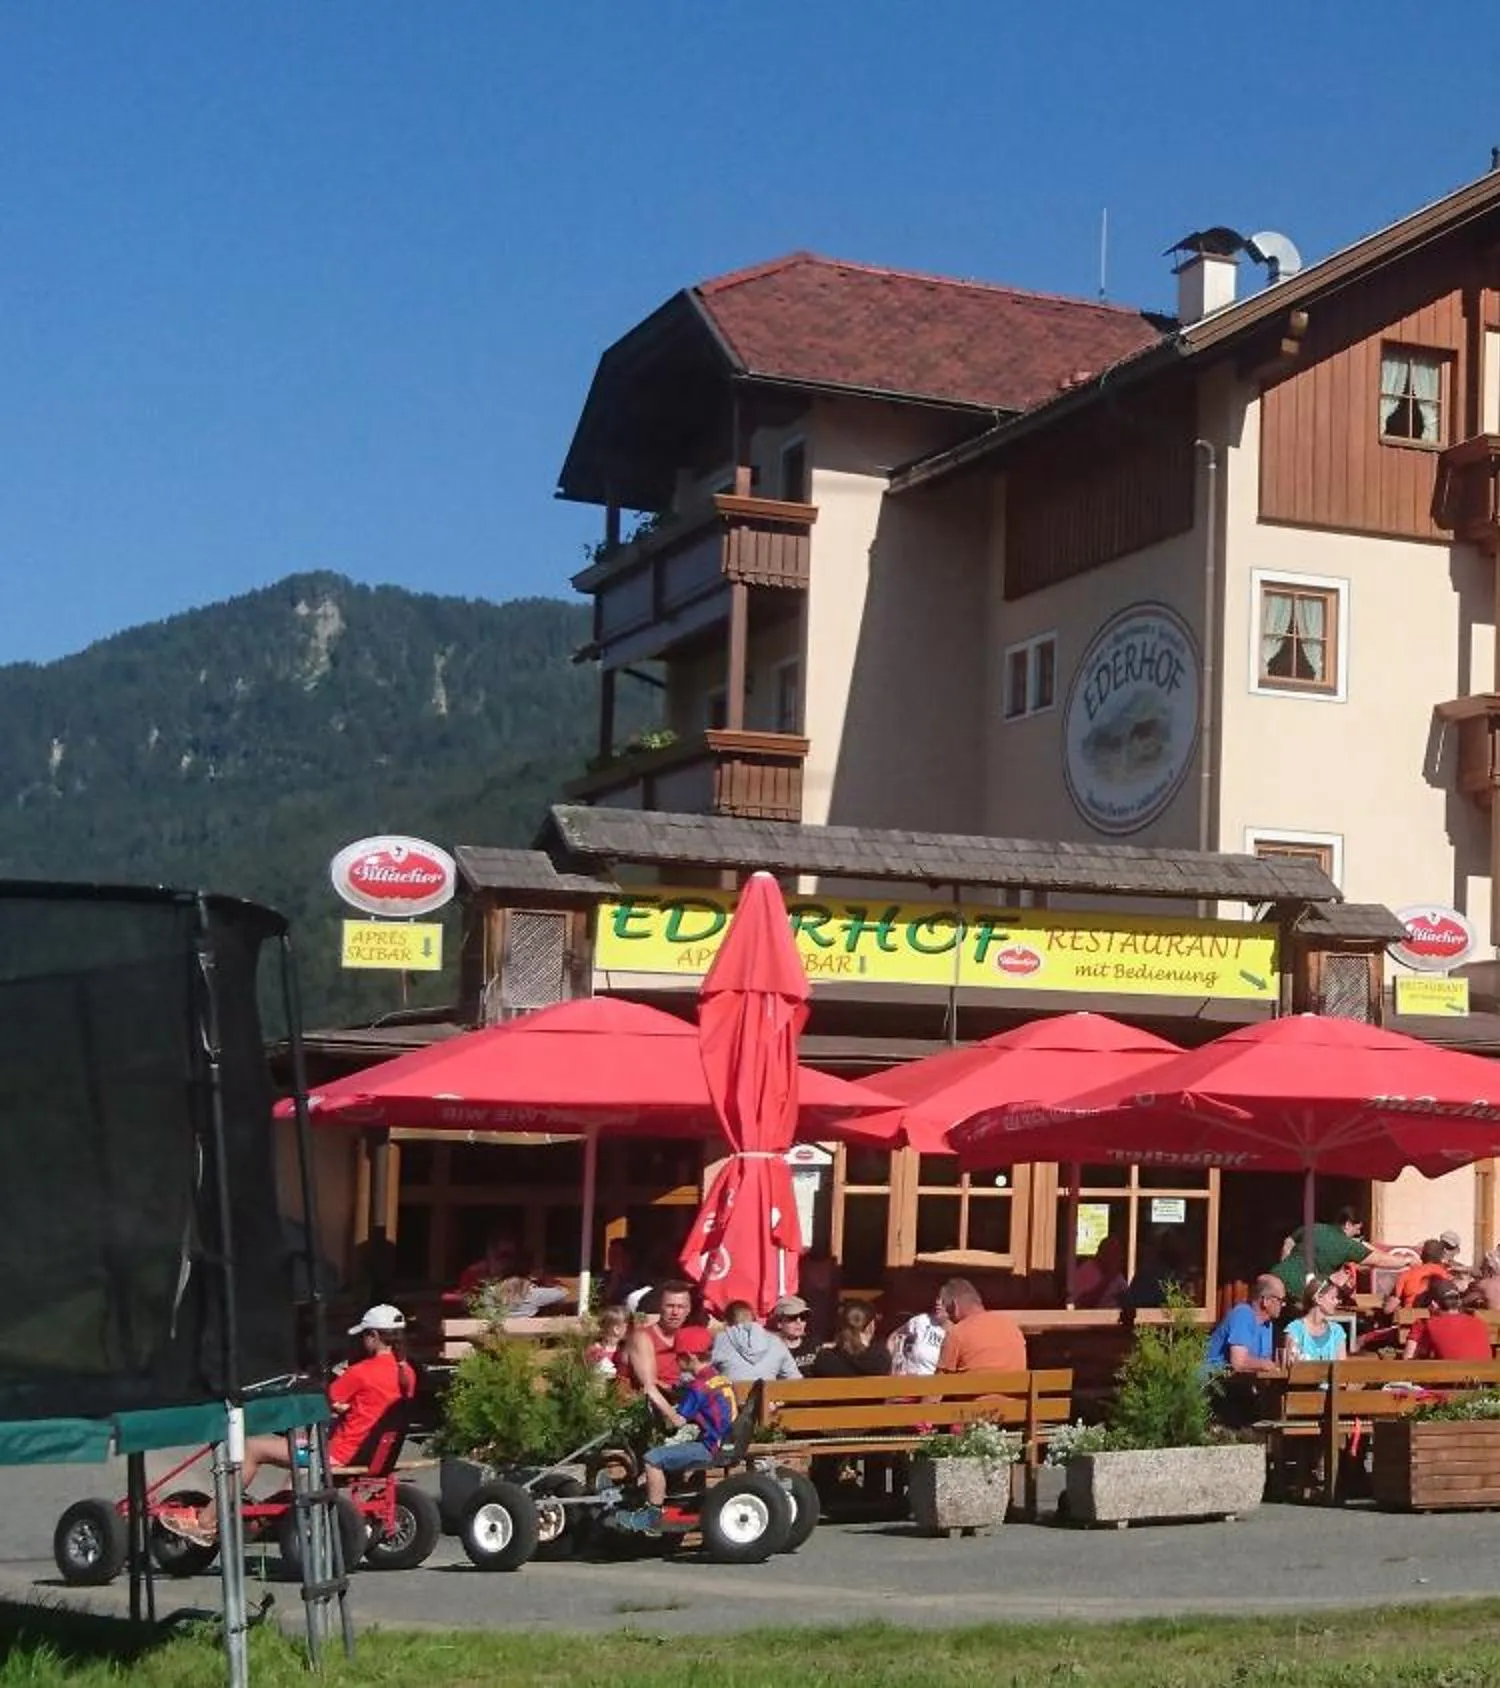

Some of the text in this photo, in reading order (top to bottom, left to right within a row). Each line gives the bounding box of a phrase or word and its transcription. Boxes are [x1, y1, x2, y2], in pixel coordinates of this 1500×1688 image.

[1084, 640, 1185, 720] EDERHOF
[607, 895, 1020, 963] EDRHOF
[1044, 925, 1244, 959] RESTAURANT
[345, 945, 412, 961] SKIBAR
[1075, 963, 1219, 988] mit Bedienung
